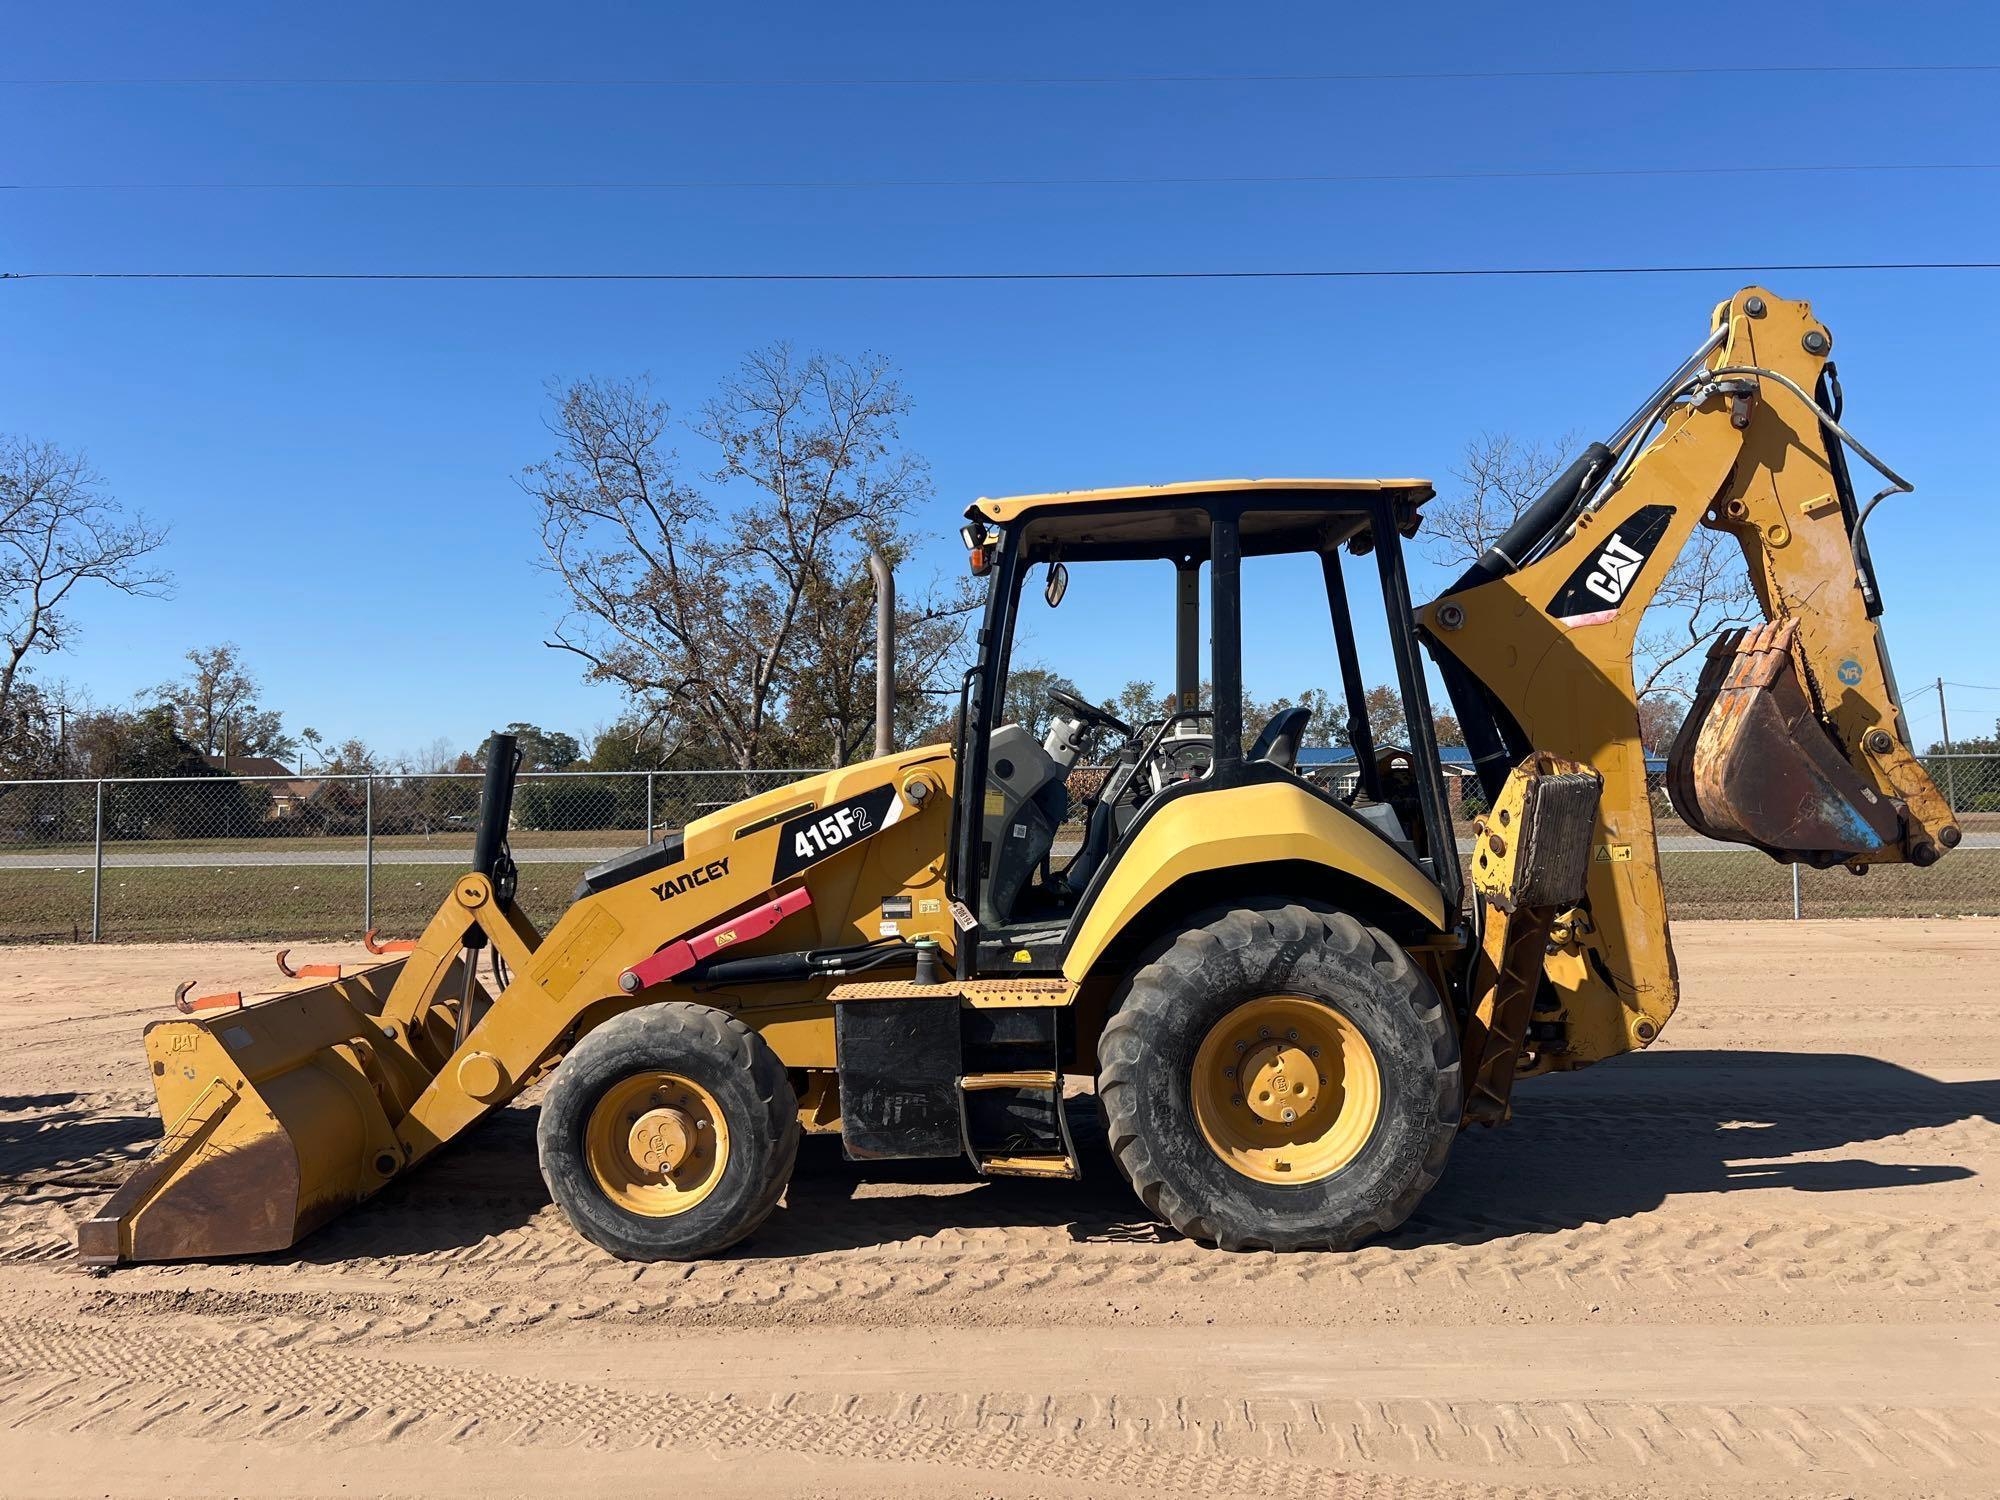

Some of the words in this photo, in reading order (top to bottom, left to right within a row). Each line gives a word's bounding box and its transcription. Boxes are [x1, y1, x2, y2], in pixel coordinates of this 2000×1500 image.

[1585, 533, 1645, 603] CAT
[794, 806, 873, 859] 415F2
[650, 857, 730, 902] YANCEY
[171, 1034, 200, 1052] CAT
[1277, 1077, 1288, 1092] CAT
[1361, 1098, 1431, 1206] HERCULES
